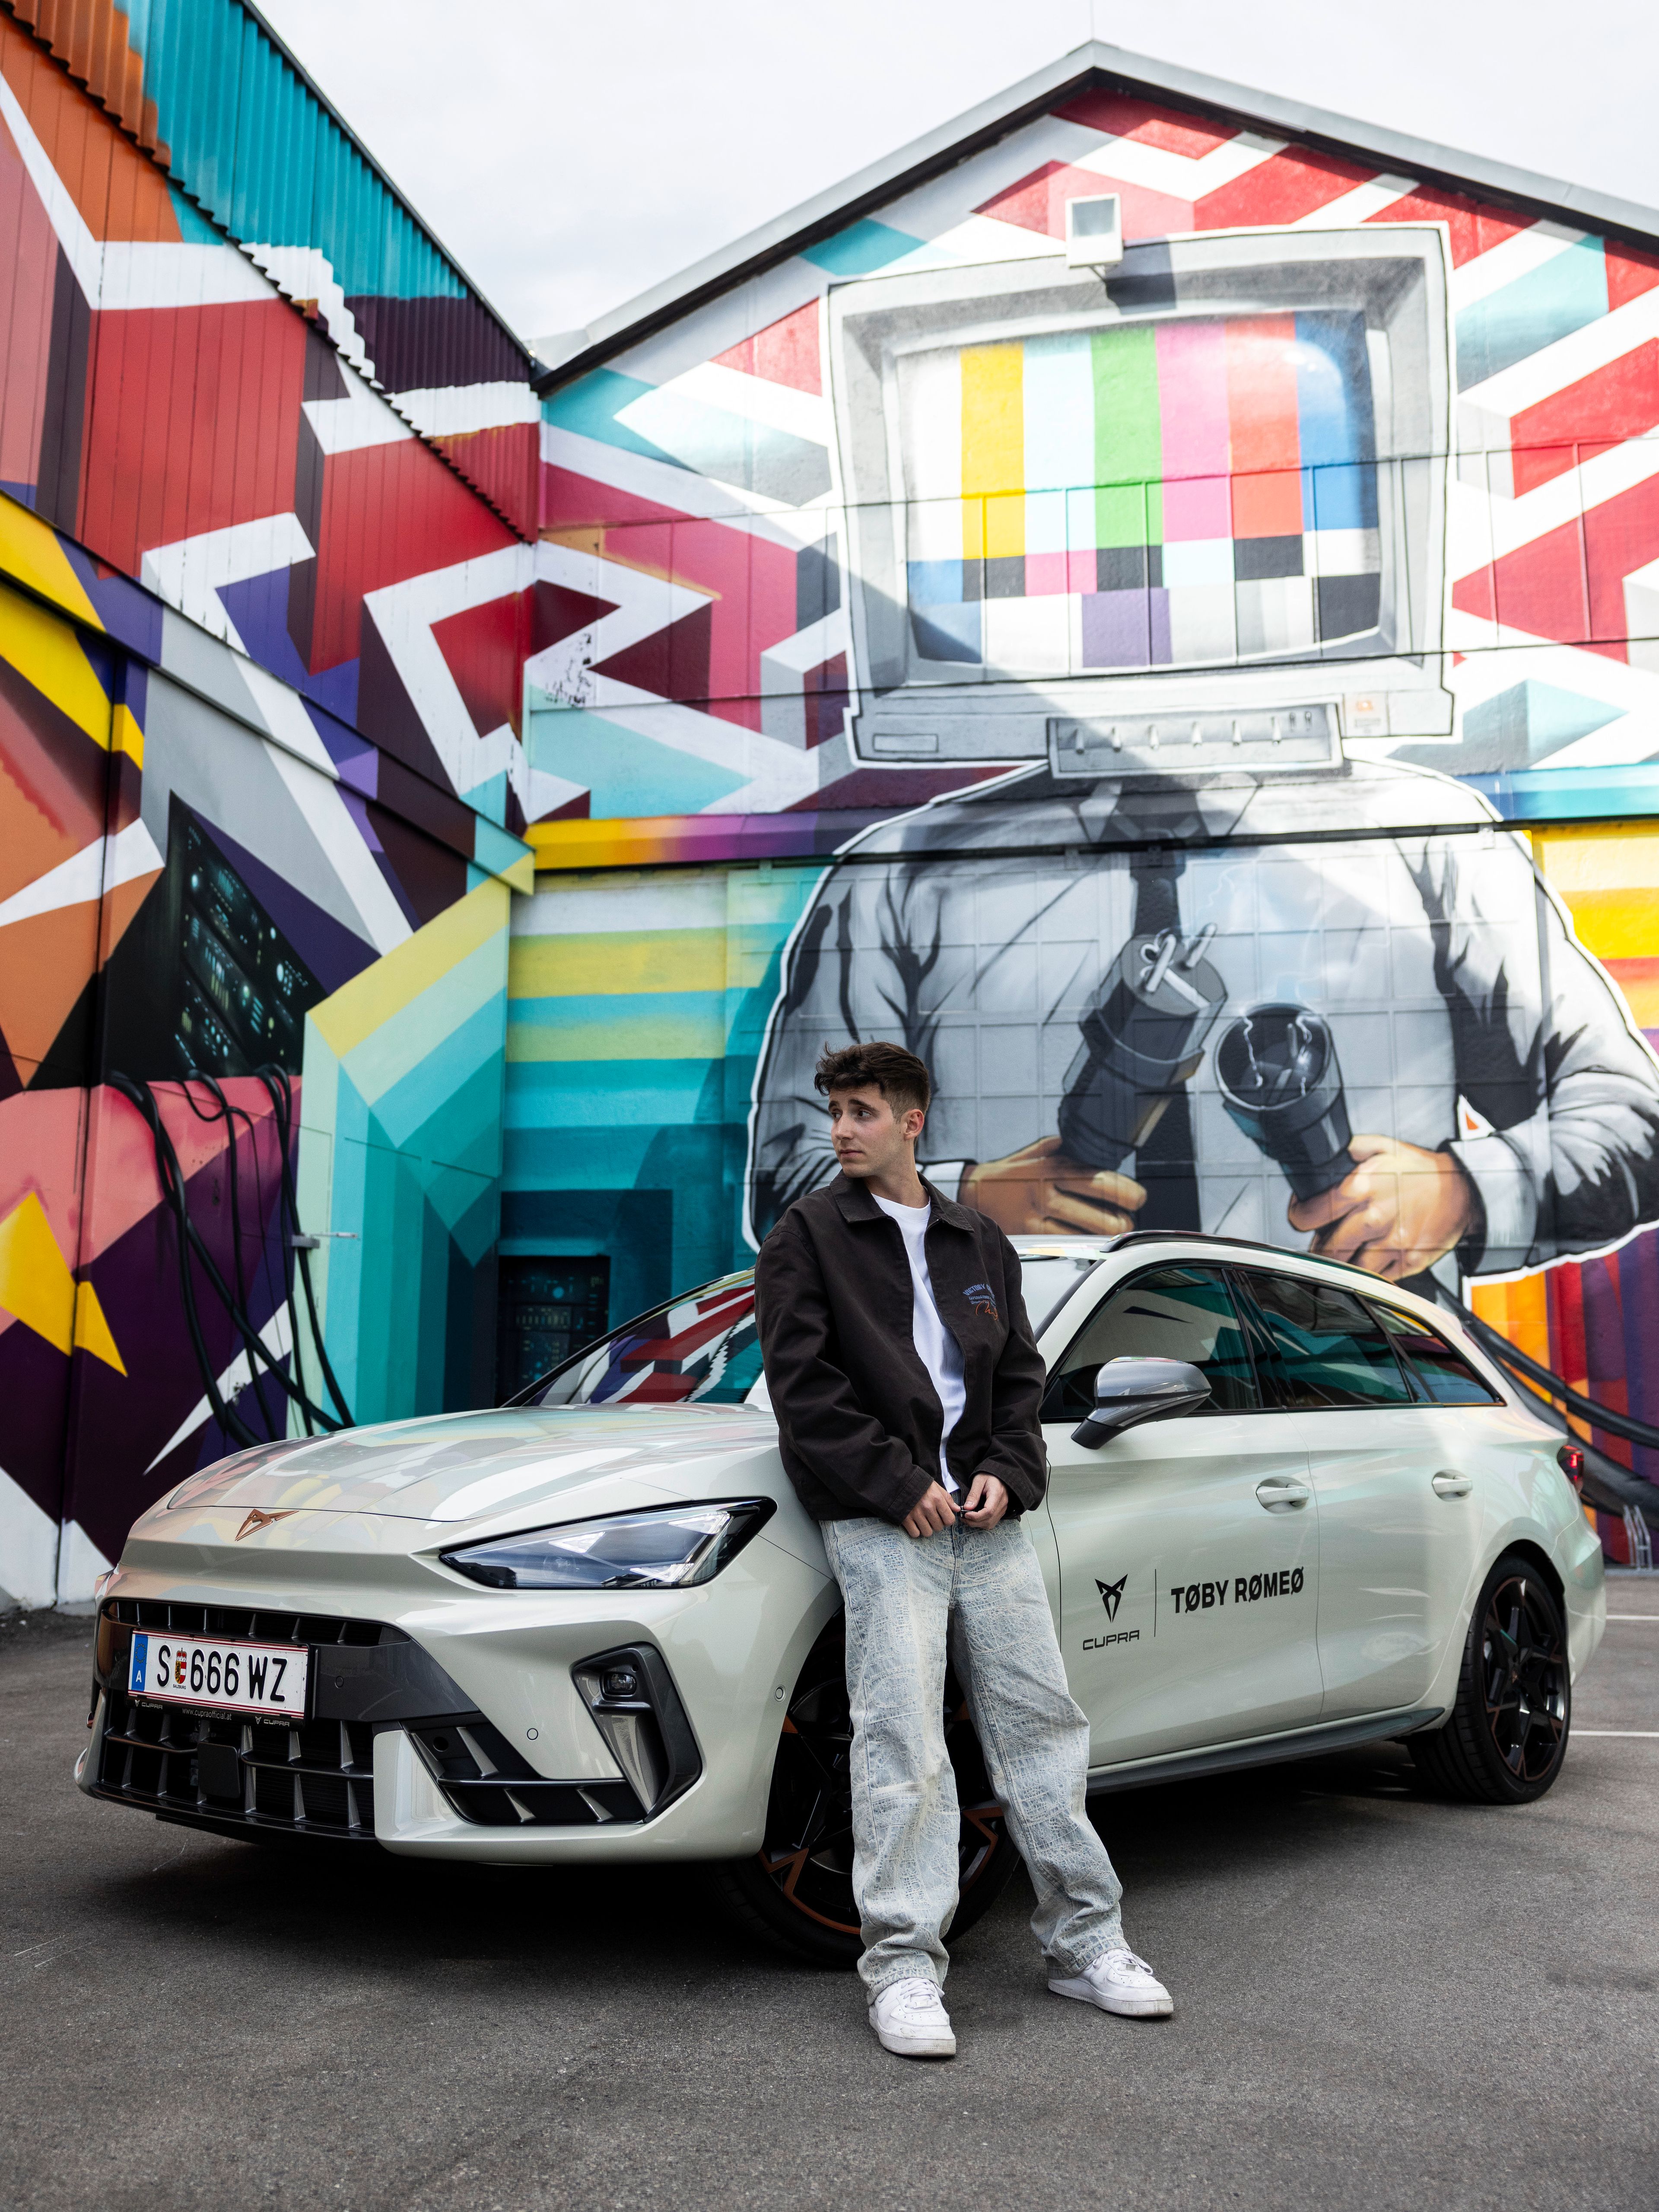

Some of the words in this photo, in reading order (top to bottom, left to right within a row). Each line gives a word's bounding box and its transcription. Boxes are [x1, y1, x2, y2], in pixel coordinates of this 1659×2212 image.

[963, 1283, 985, 1295] VICTORY
[1171, 1580, 1229, 1614] TØBY
[1235, 1566, 1304, 1603] RØMEØ
[1083, 1630, 1140, 1650] CUPRA
[136, 1670, 142, 1683] A
[157, 1644, 171, 1687] S
[190, 1649, 240, 1696] 666
[249, 1655, 288, 1702] WZ
[182, 1708, 232, 1720] www.cupraofficial.at
[264, 1719, 290, 1727] CUPRA
